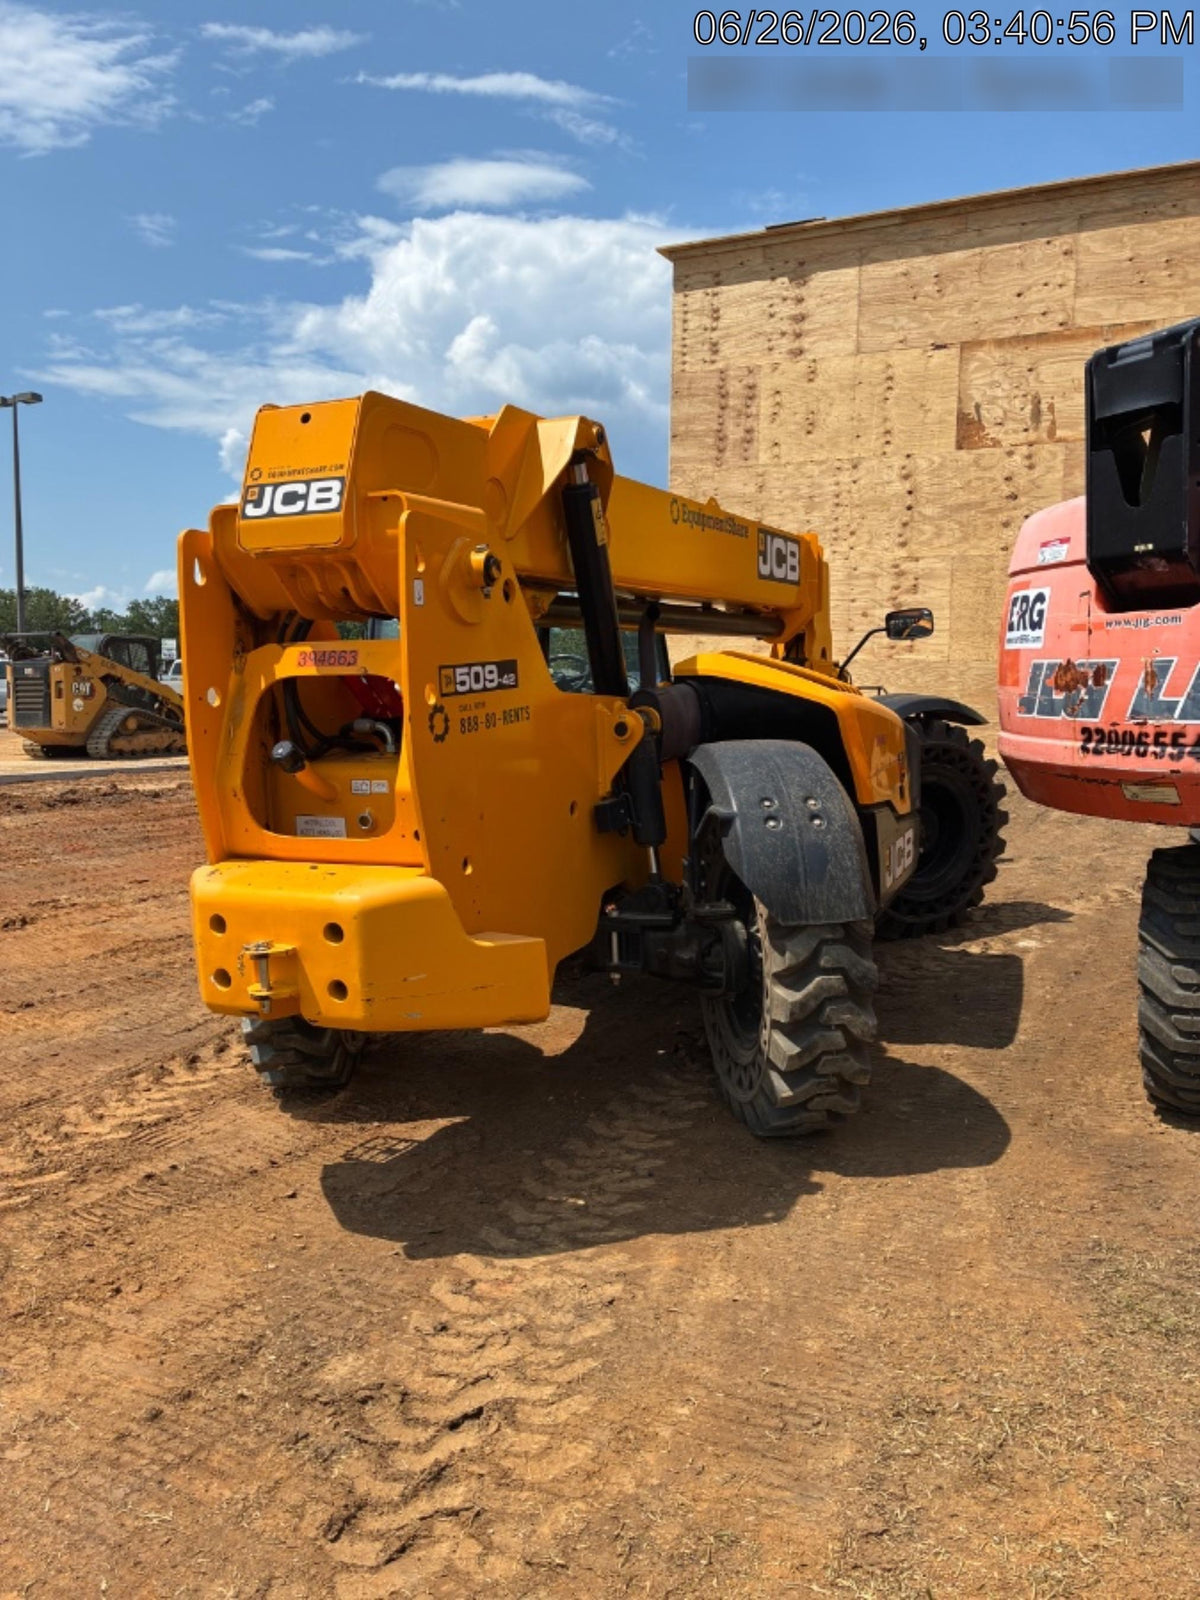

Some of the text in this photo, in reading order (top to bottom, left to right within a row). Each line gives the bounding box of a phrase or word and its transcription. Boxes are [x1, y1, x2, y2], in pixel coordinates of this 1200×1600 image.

[244, 479, 342, 517] JCB
[758, 533, 800, 581] JCB
[1008, 591, 1046, 632] ERG
[455, 664, 516, 692] 509-42
[885, 828, 914, 889] JCB
